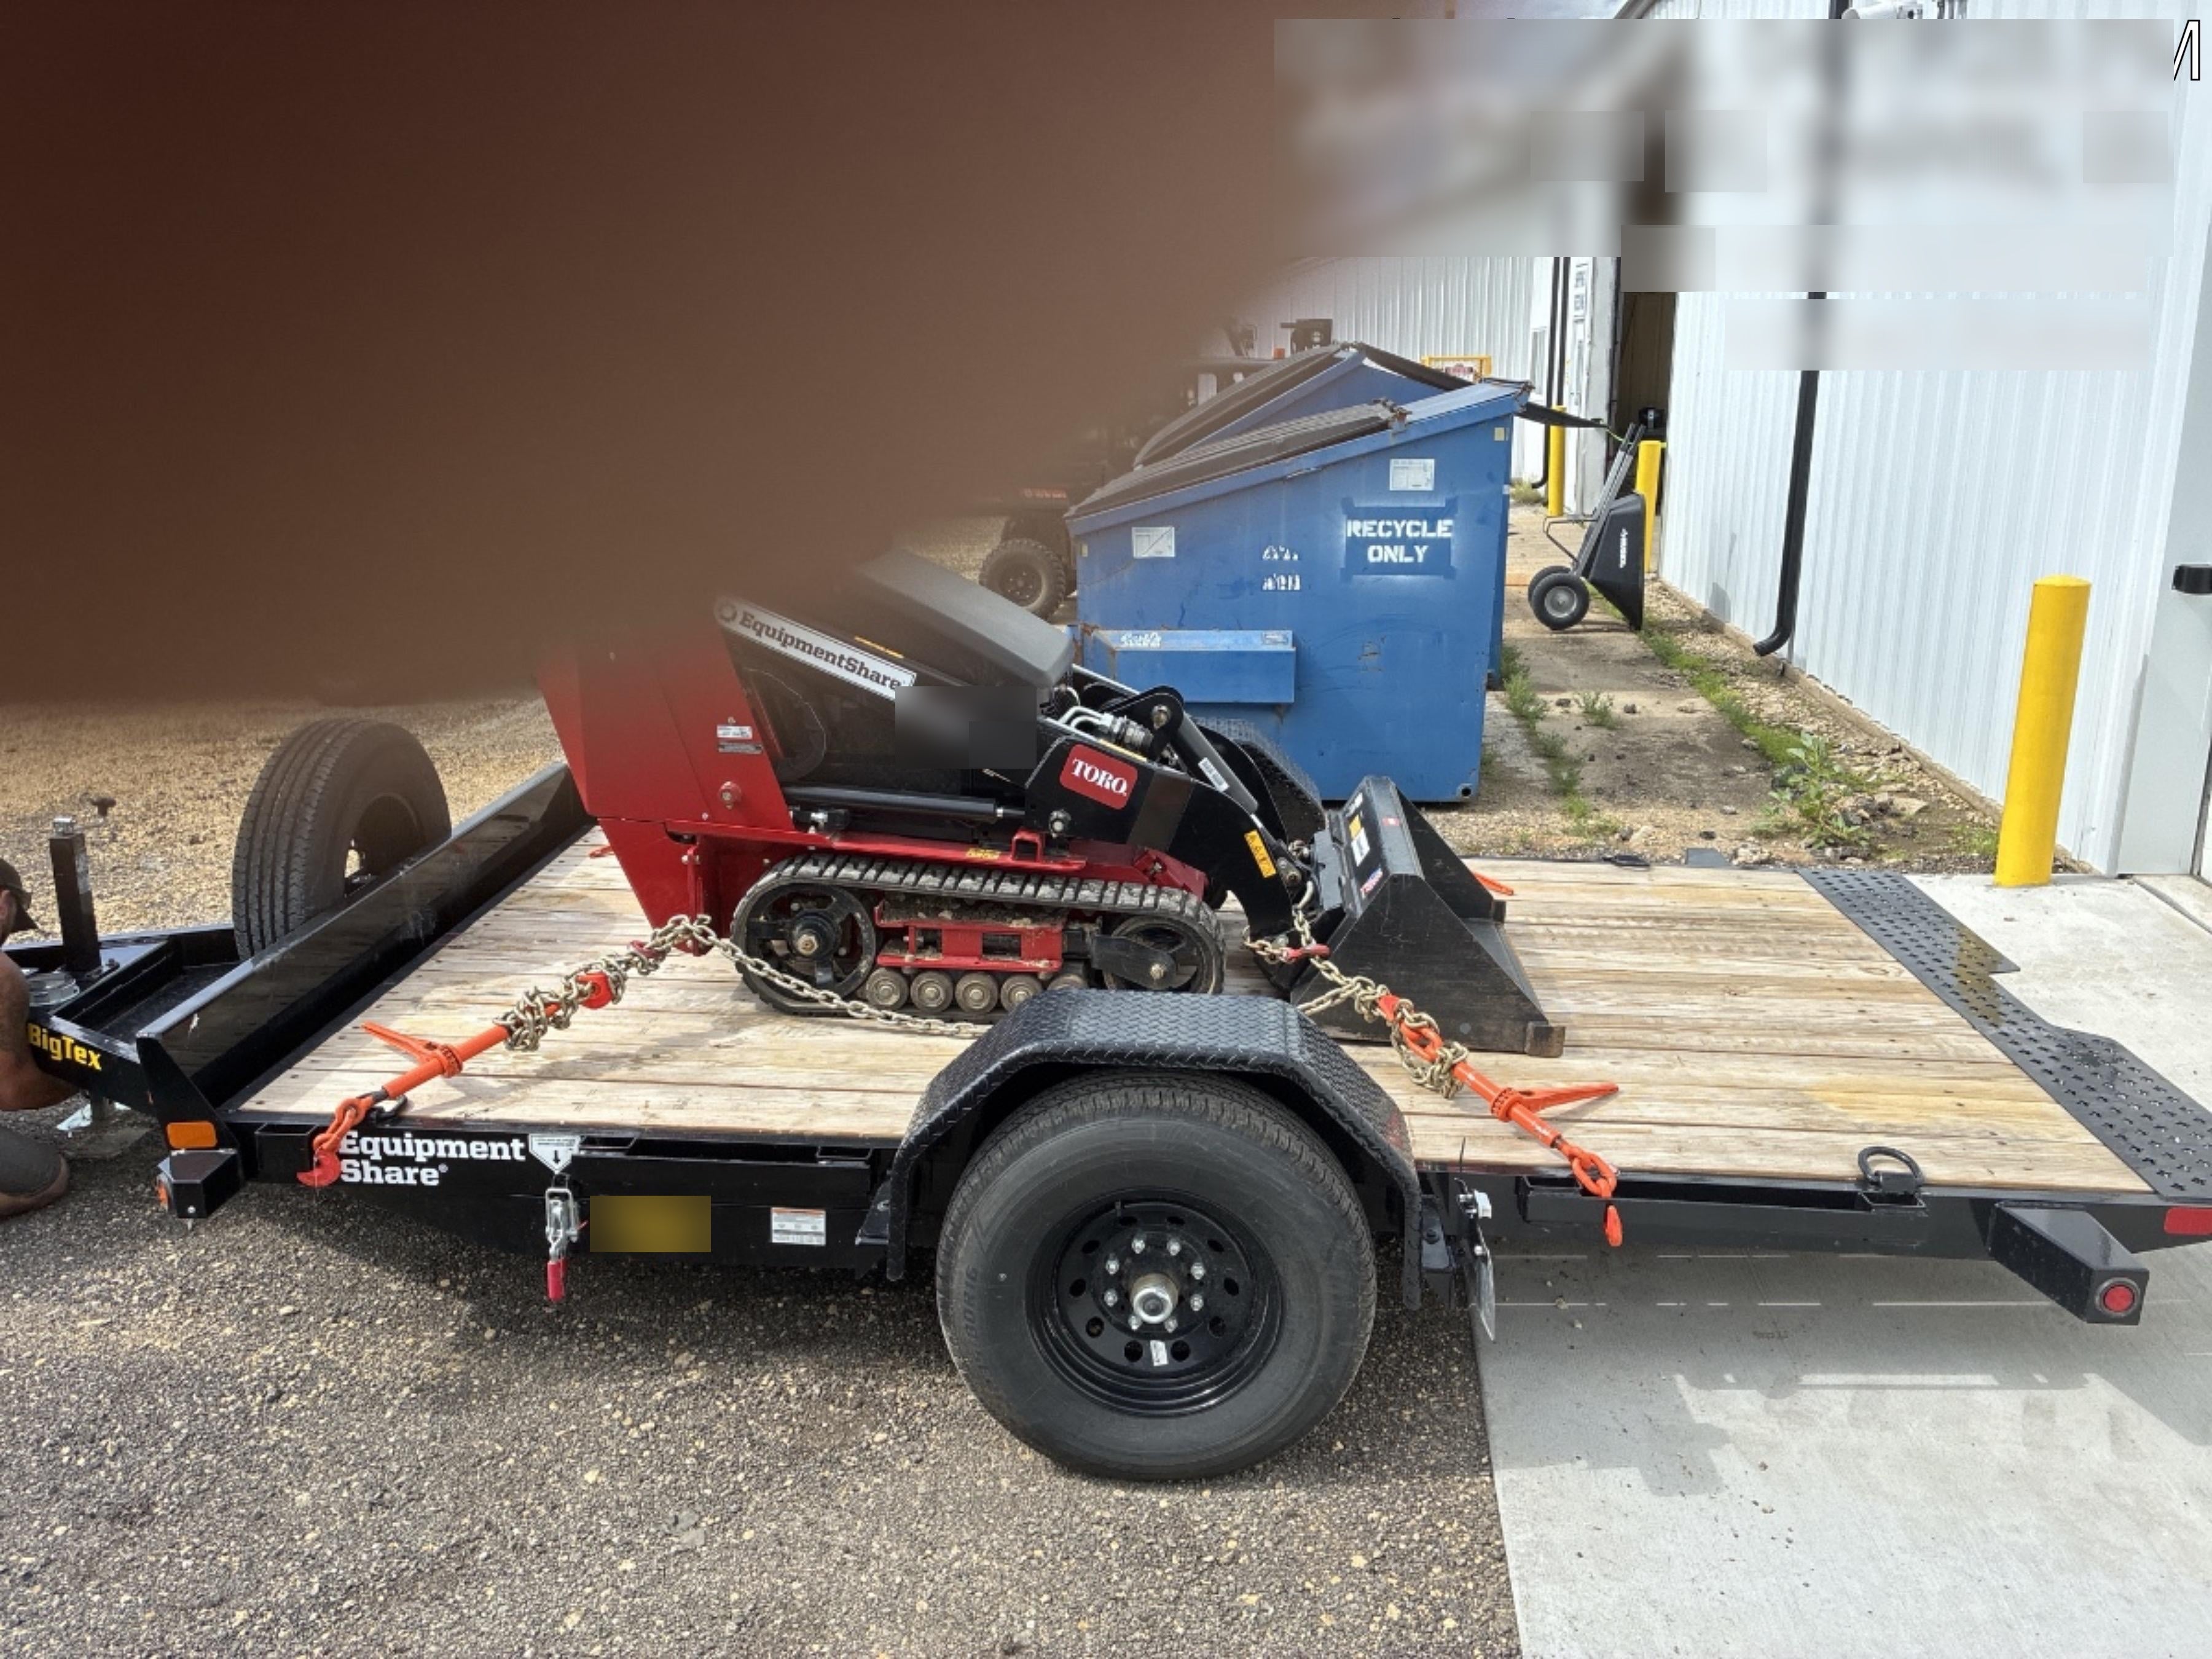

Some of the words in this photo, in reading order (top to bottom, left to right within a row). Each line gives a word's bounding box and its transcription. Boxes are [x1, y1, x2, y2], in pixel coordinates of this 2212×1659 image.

[1347, 519, 1454, 538] RECYCLE
[1367, 545, 1428, 563] ONLY
[739, 610, 901, 690] EquipmentShare
[1072, 757, 1128, 795] TORO
[27, 1022, 103, 1072] BigTex
[339, 1130, 527, 1163] Equipment
